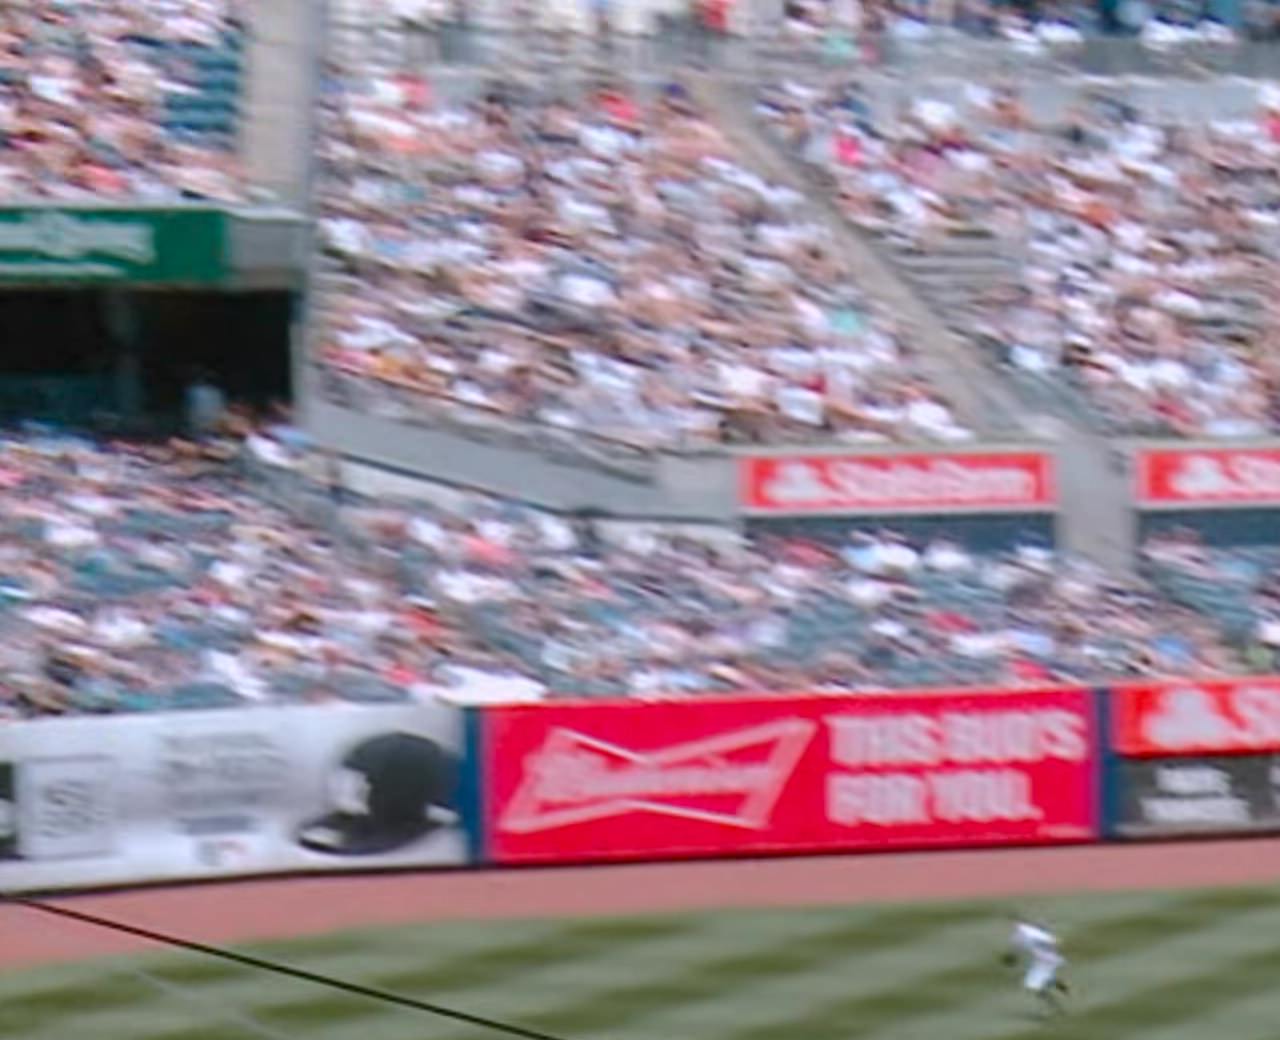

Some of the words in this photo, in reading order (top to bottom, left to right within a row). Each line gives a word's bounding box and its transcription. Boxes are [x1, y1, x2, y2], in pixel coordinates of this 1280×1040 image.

[822, 711, 938, 764] THIS
[937, 708, 1088, 761] BUD'S
[824, 773, 928, 825] FOR
